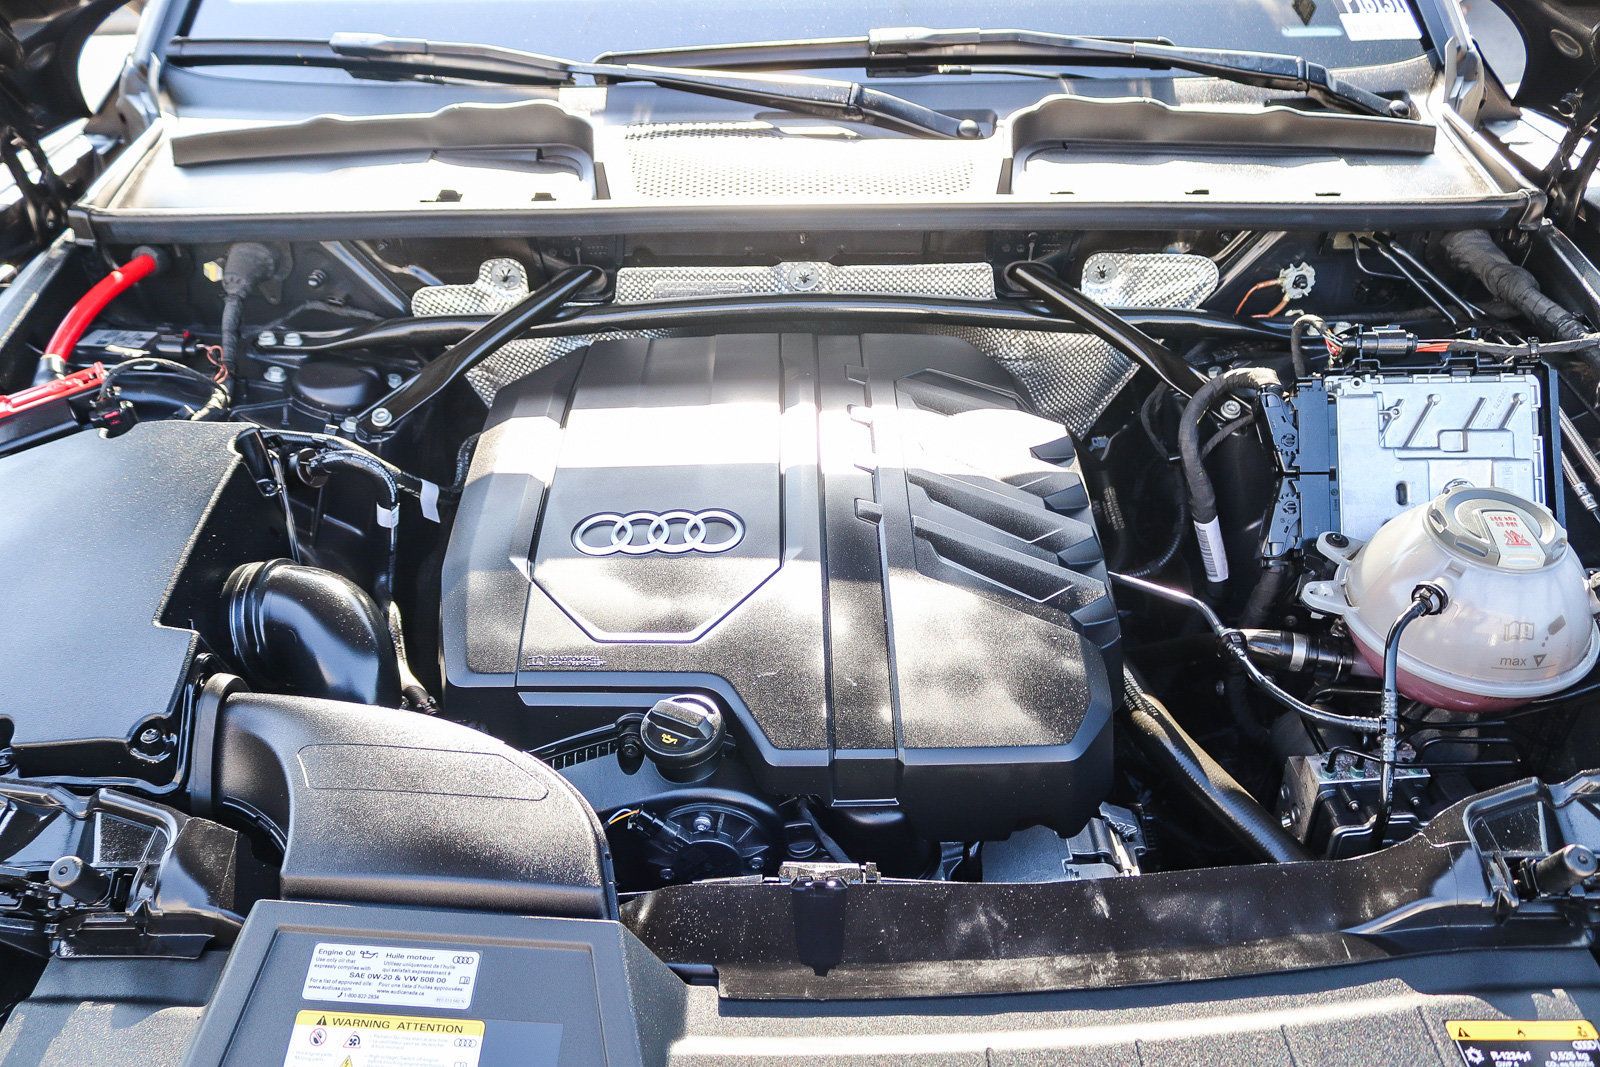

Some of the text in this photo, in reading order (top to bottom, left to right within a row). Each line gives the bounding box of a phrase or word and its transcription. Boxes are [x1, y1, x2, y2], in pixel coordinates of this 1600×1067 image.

[1500, 656, 1527, 667] max
[318, 948, 344, 956] Engine
[386, 952, 405, 960] Huile
[332, 1017, 464, 1034] WARNING ATTENTION
